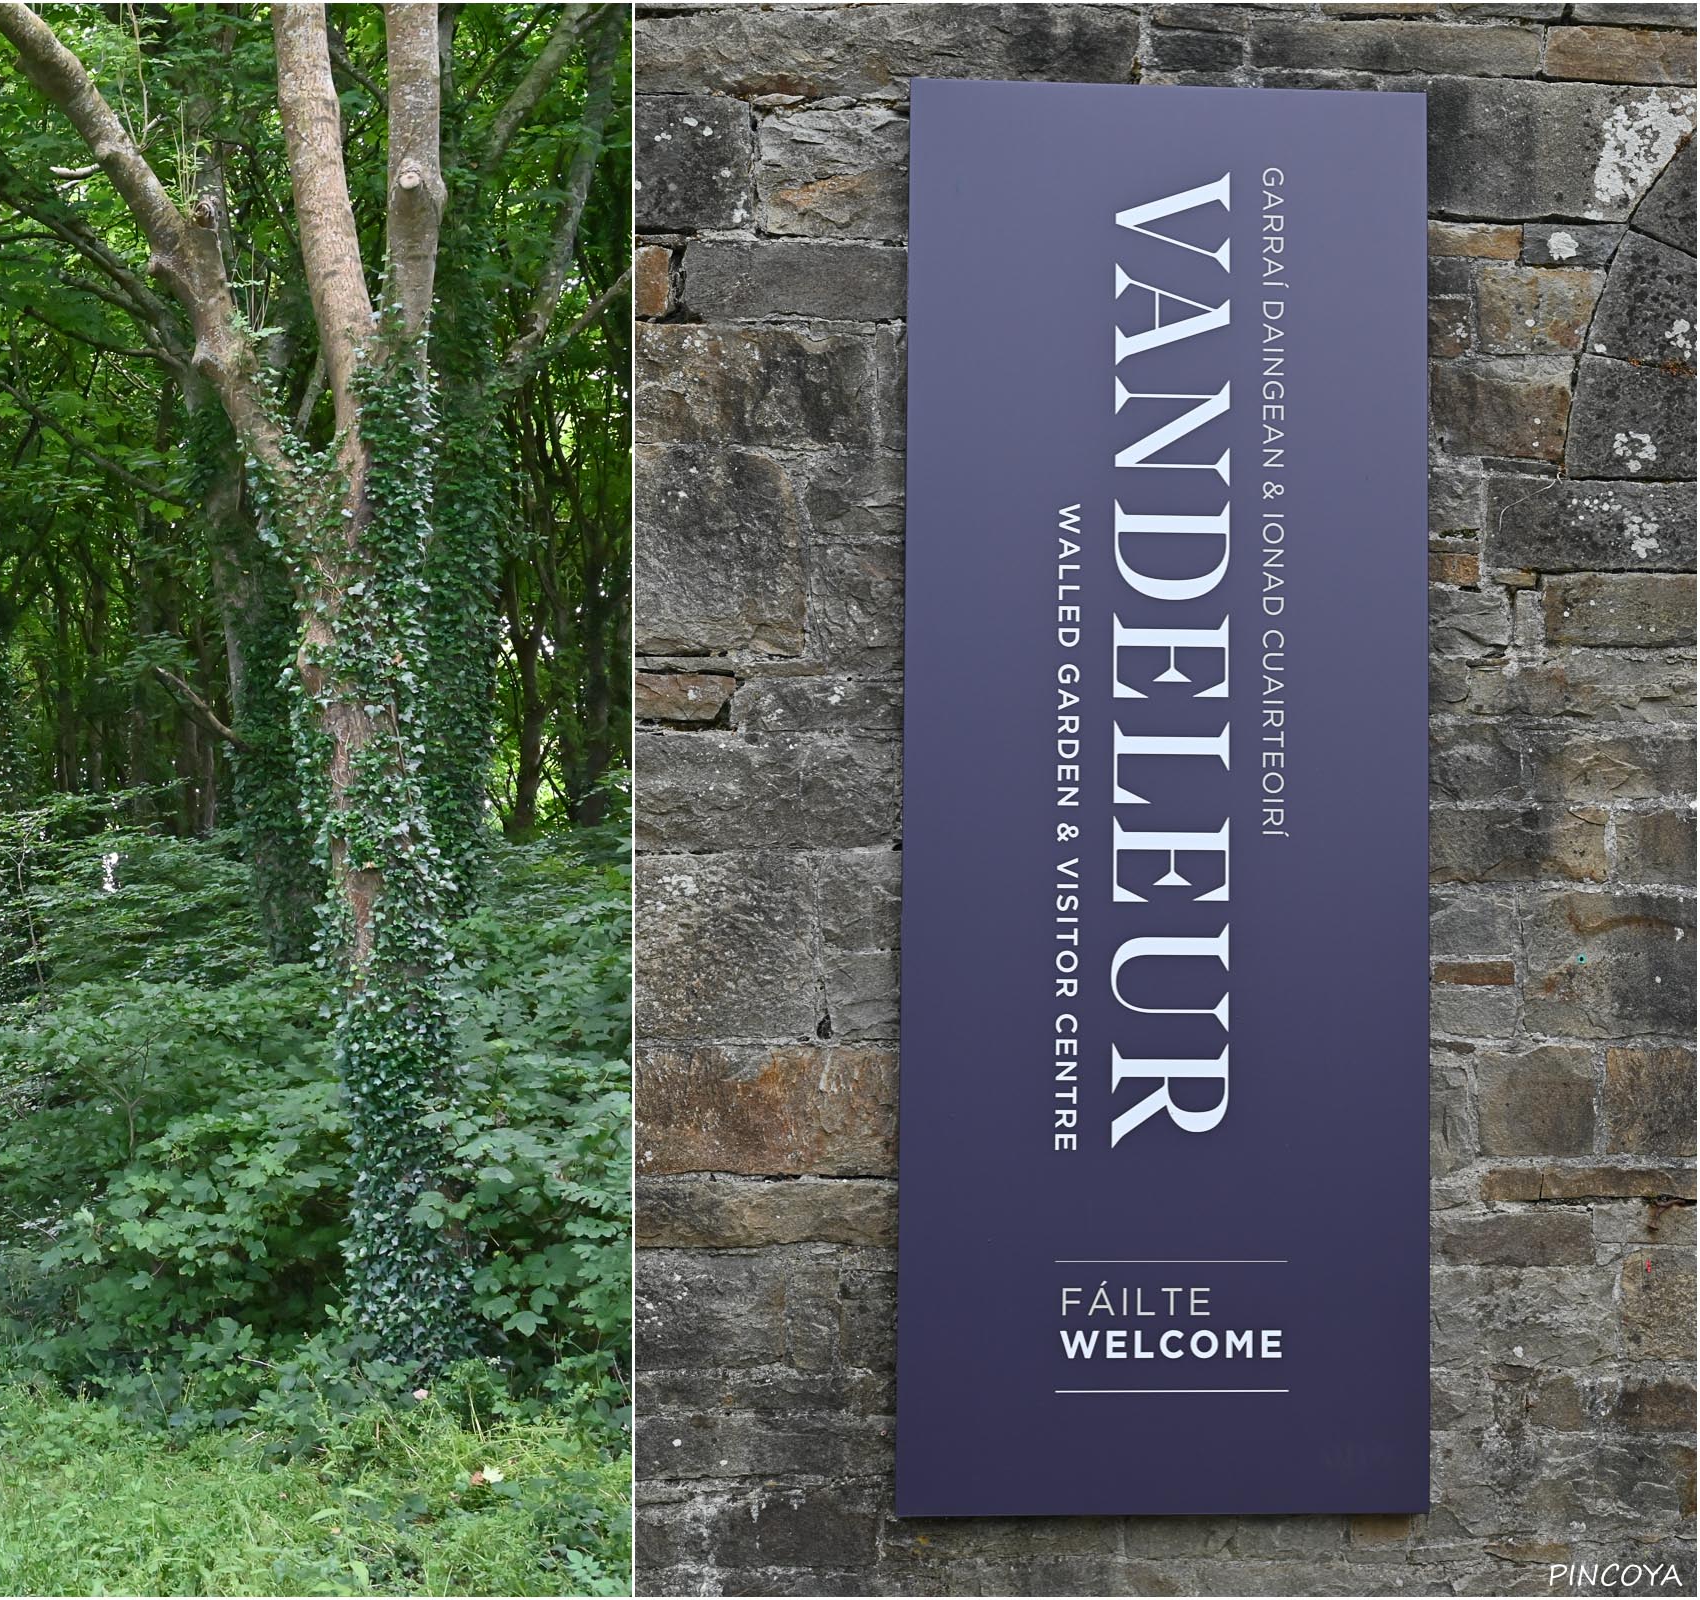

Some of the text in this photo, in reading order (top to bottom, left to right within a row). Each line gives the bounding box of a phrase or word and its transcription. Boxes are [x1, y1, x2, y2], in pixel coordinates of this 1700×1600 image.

[1110, 171, 1231, 1149] VANDELEUR
[1262, 167, 1290, 838] GARRAÍ DAINGEAN & IONAD CUAIRTEOIRÍ
[1054, 503, 1081, 1151] WALLED GARDEN & VISITOR CENTRE
[1059, 1329, 1283, 1360] WELCOME
[1061, 1280, 1211, 1316] FÁILTE
